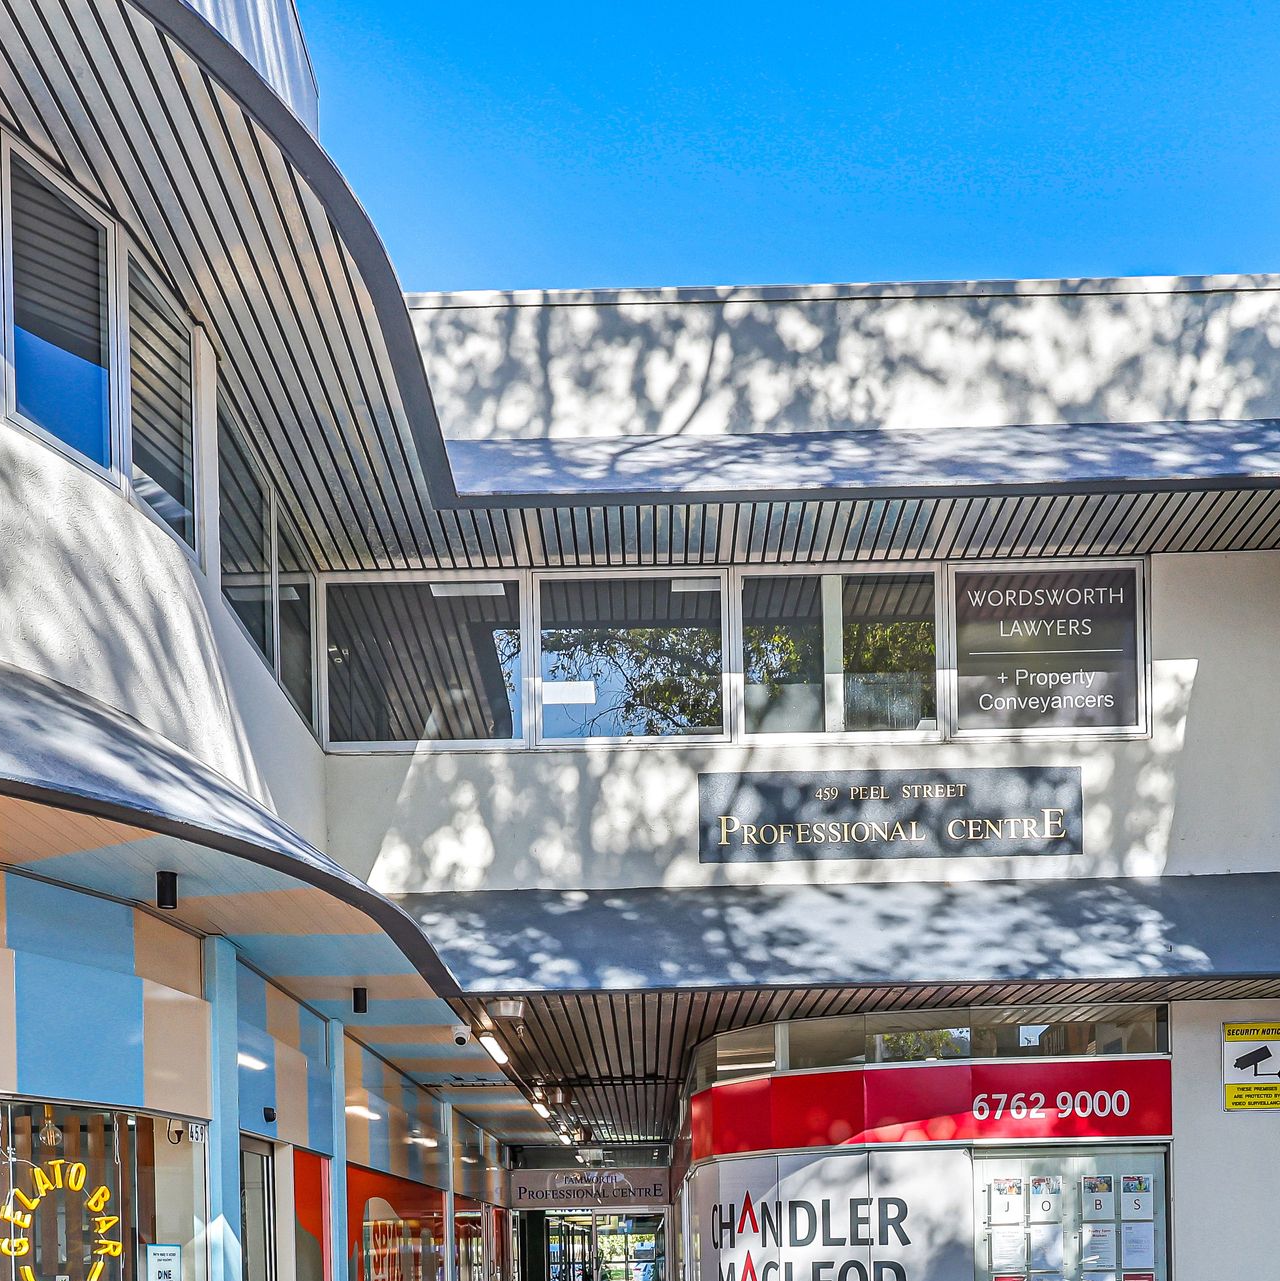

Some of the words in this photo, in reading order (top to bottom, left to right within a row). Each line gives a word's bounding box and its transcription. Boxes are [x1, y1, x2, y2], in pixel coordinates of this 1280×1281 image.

[967, 588, 1124, 607] WORDSWORTH
[999, 619, 1092, 637] LAWYERS
[1015, 669, 1096, 688] Property
[979, 693, 1115, 713] Conveyancers
[815, 786, 839, 801] 459
[849, 785, 890, 800] PEEL
[902, 783, 967, 799] STREET
[717, 815, 927, 845] PROFESSIONAL
[947, 808, 1067, 840] CENTRE
[1227, 1028, 1261, 1037] SECURITY
[972, 1092, 1046, 1121] 6762
[1056, 1089, 1131, 1119] 9000
[563, 1175, 618, 1185] TAMWORTH
[517, 1186, 610, 1200] PROFESSIONAL
[612, 1183, 664, 1198] CENTRE
[0, 1158, 88, 1257] GELATO
[86, 1185, 123, 1258] BAR
[1004, 1201, 1010, 1213] J
[1041, 1200, 1052, 1212] O
[1094, 1199, 1103, 1210] B
[1133, 1198, 1141, 1210] S
[711, 1189, 913, 1250] CHANDLER
